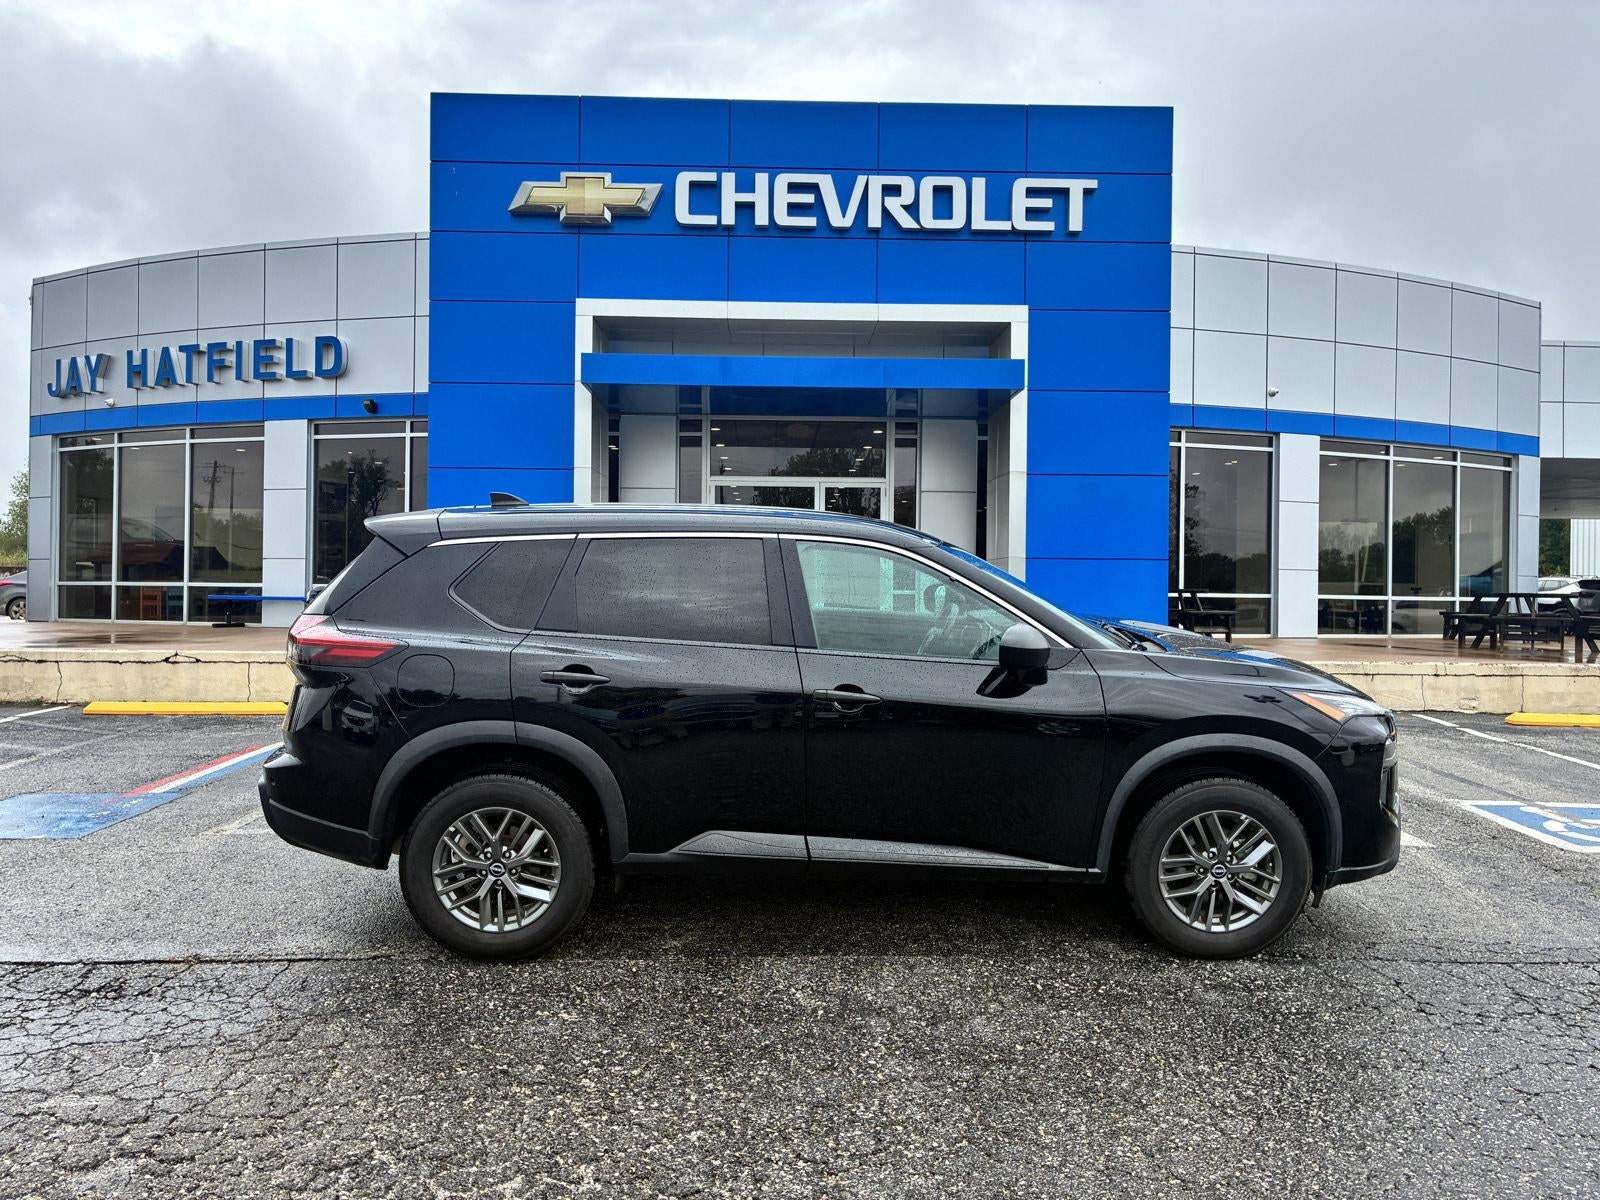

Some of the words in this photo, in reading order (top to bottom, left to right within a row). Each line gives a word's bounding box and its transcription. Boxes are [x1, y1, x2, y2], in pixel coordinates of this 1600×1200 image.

[674, 171, 1098, 233] CHEVROLET
[47, 353, 109, 398] JAY
[126, 335, 347, 389] HATFIELD
